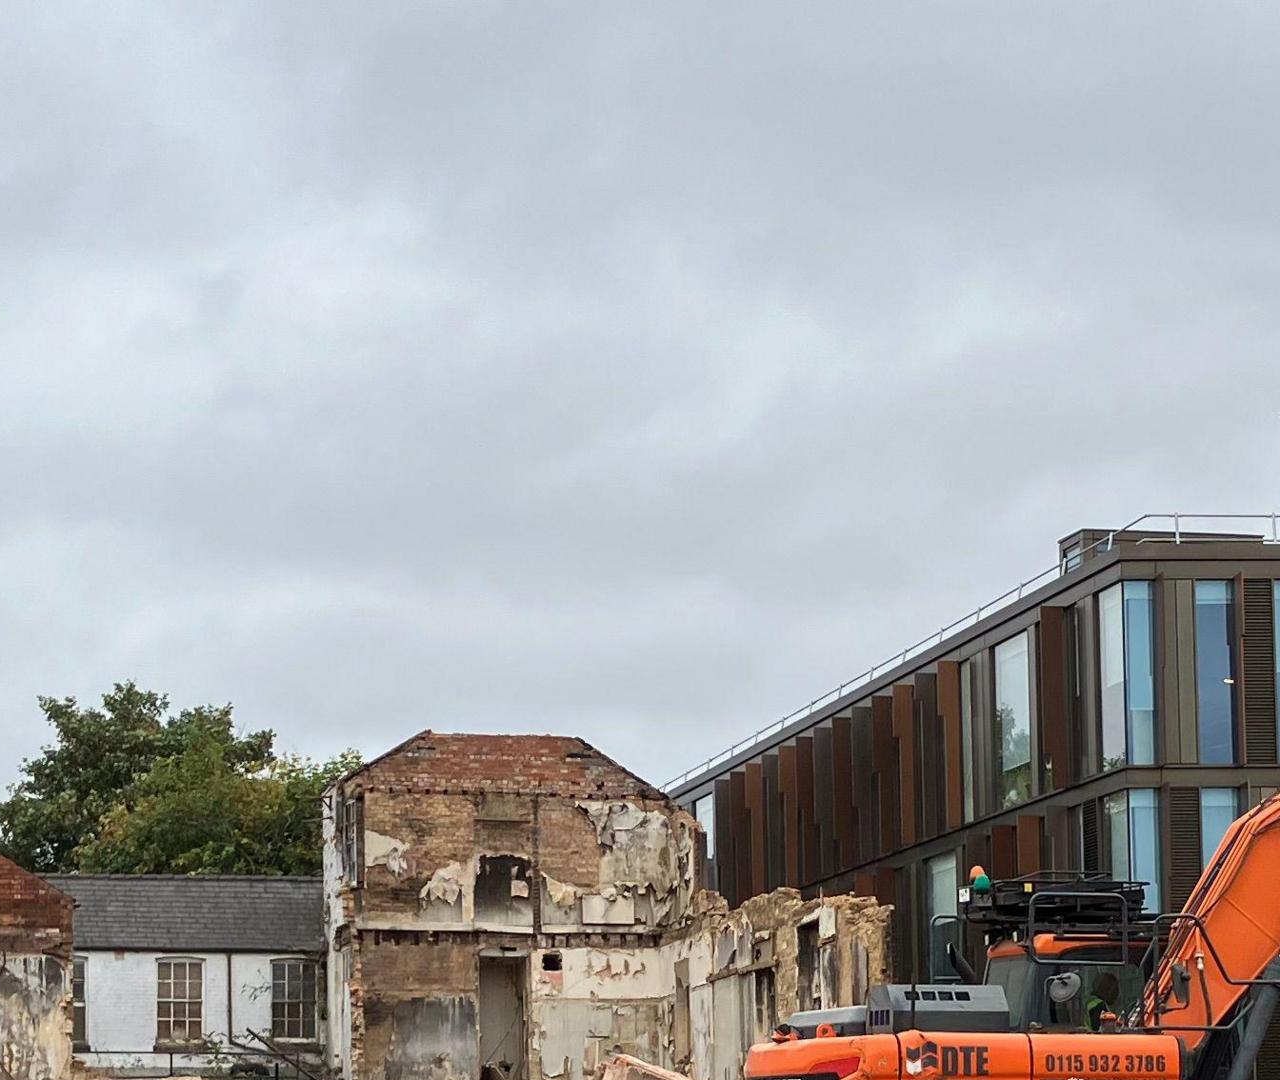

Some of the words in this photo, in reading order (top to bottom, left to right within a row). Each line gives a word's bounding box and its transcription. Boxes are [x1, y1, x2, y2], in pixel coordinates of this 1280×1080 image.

[941, 1046, 989, 1076] DTE
[1045, 1054, 1084, 1072] 0115
[1089, 1054, 1120, 1072] 932
[1125, 1054, 1166, 1072] 3786
